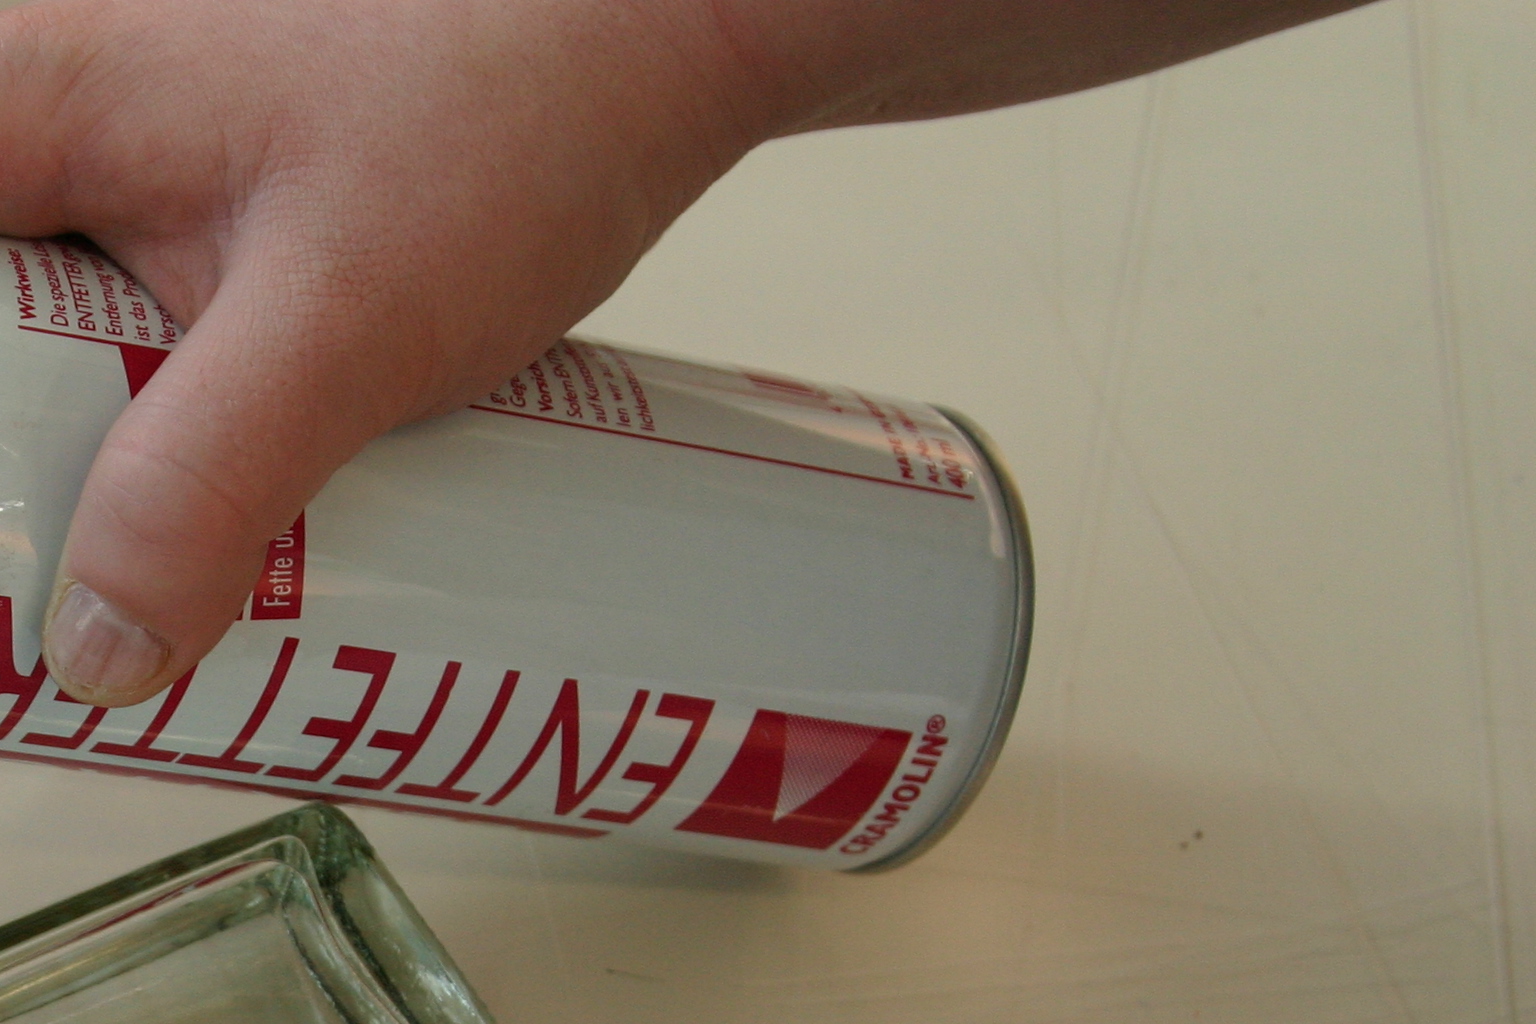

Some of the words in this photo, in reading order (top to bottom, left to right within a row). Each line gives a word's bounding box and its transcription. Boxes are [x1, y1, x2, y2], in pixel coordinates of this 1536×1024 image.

[7, 248, 37, 320] Wirkweise:
[37, 257, 69, 302] spezielle
[62, 261, 96, 331] ENTFETTER
[129, 301, 147, 321] das
[50, 303, 69, 327] Die
[134, 325, 151, 341] ist
[563, 380, 583, 418] Sofern
[586, 401, 607, 423] auf
[616, 408, 631, 427] len
[263, 557, 294, 606] Fette
